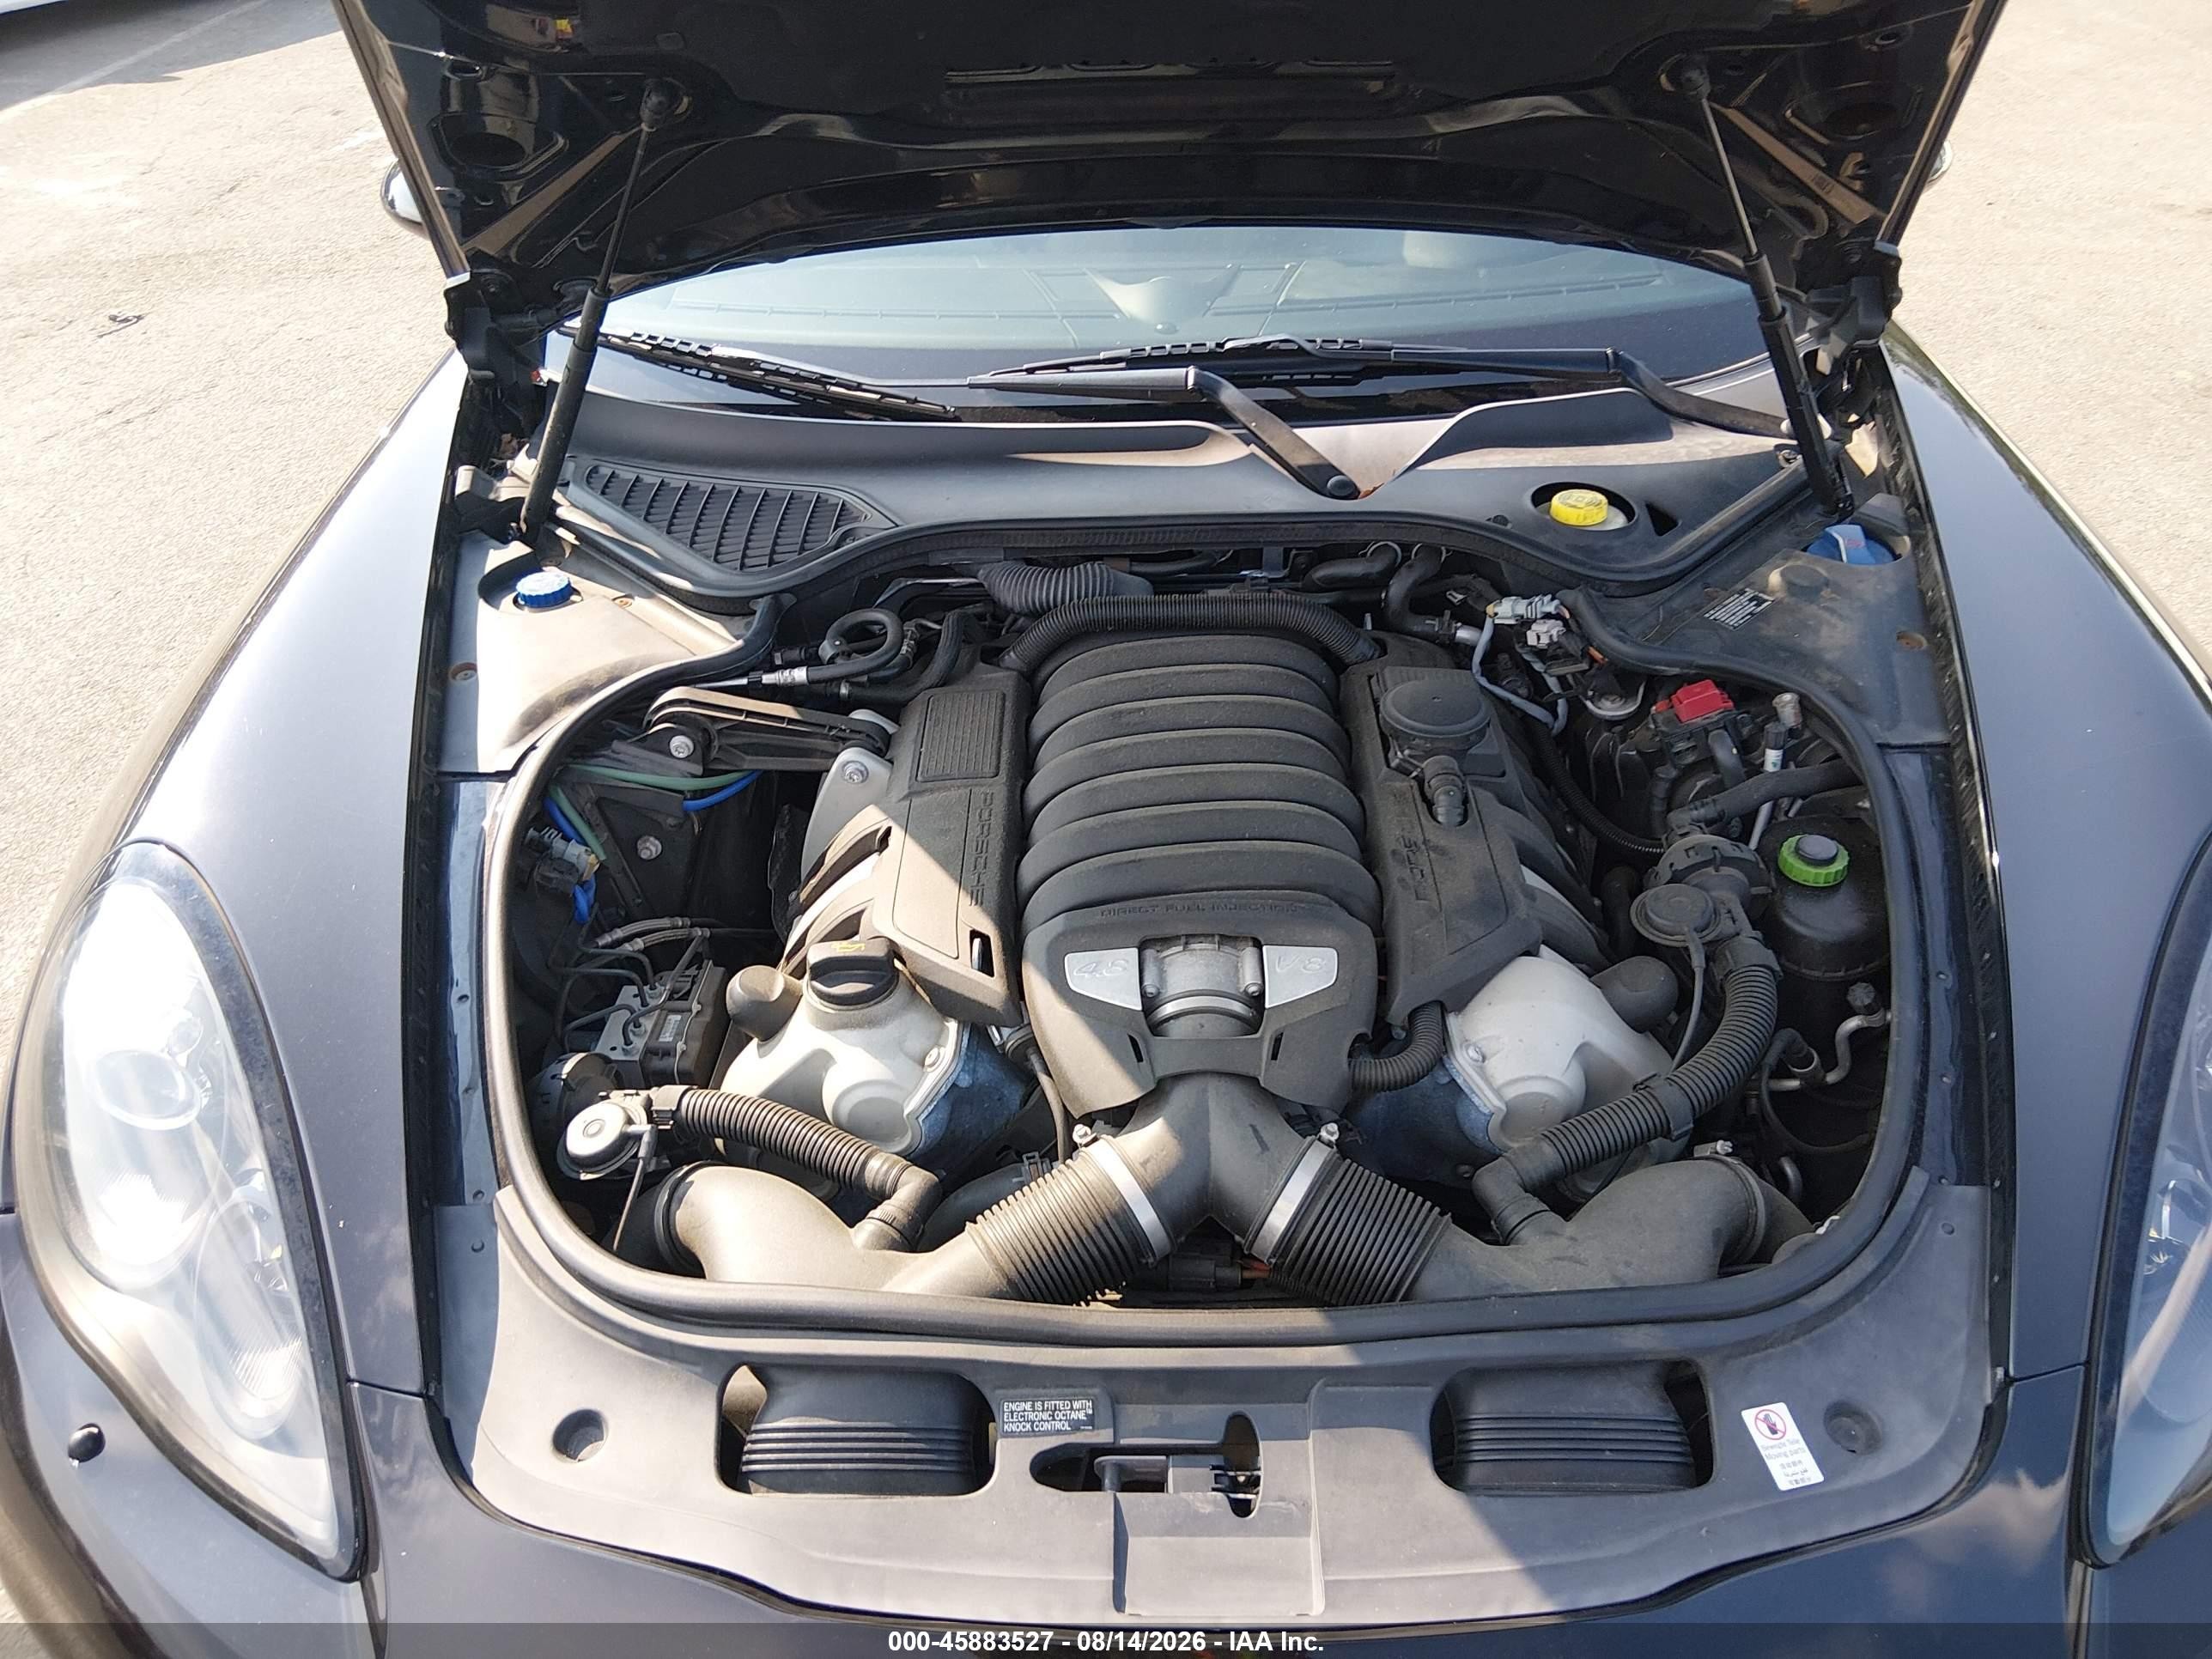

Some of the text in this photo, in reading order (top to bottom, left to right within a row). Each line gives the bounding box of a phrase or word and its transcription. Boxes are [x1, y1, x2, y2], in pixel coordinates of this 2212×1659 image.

[969, 792, 994, 907] PORSCHE
[1100, 904, 1158, 917] DIRECT
[1165, 903, 1206, 914] FUEL
[1073, 959, 1129, 978] 4.8
[1275, 955, 1327, 974] V8
[1004, 1399, 1092, 1413] ENGINE IS FITTED WITH
[1004, 1411, 1053, 1422] ELECTRONIC
[1004, 1419, 1072, 1432] KNOCK CONTROL
